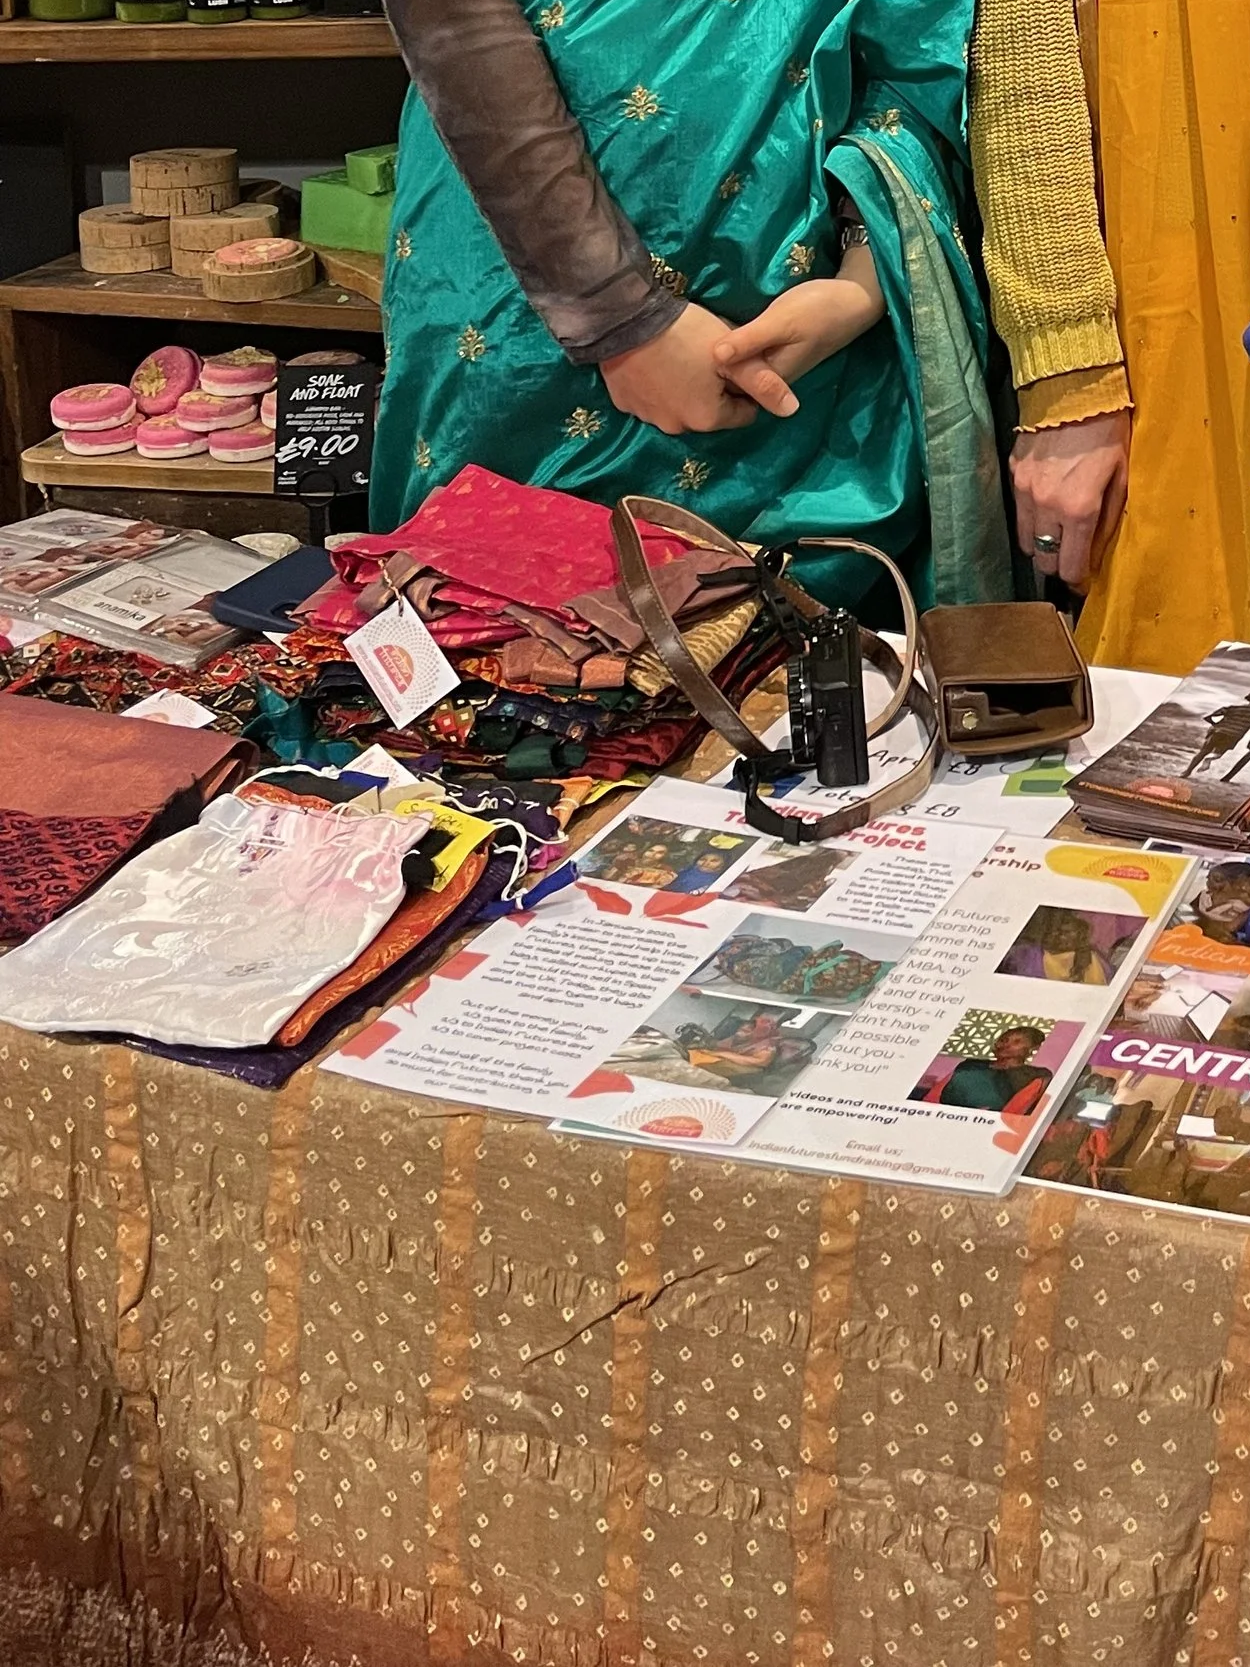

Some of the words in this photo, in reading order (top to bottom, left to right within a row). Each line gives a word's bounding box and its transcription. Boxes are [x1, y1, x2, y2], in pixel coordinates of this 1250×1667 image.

[307, 374, 344, 387] SOAK
[289, 387, 319, 401] AND
[321, 384, 365, 399] FLOAT
[275, 434, 359, 463] £9.00
[93, 601, 146, 622] anamika
[948, 760, 982, 776] £8
[924, 804, 961, 817] £8
[867, 820, 926, 836] ures
[951, 909, 1011, 925] Futures
[969, 938, 996, 950] has
[1158, 932, 1250, 967] Indian
[939, 951, 959, 962] me
[964, 951, 979, 963] to
[951, 965, 972, 978] by
[907, 972, 930, 985] for
[934, 978, 959, 990] my
[884, 986, 915, 1000] and
[919, 992, 964, 1006] travel
[897, 1018, 930, 1032] have
[852, 1029, 920, 1047] possible
[863, 1046, 895, 1061] you
[780, 1103, 802, 1111] are
[805, 1105, 899, 1125] empowering!
[788, 1090, 833, 1104] videos
[836, 1096, 863, 1109] and
[866, 1101, 932, 1117] messages
[936, 1109, 968, 1123] from
[973, 1113, 996, 1126] the
[845, 1140, 881, 1153] Email
